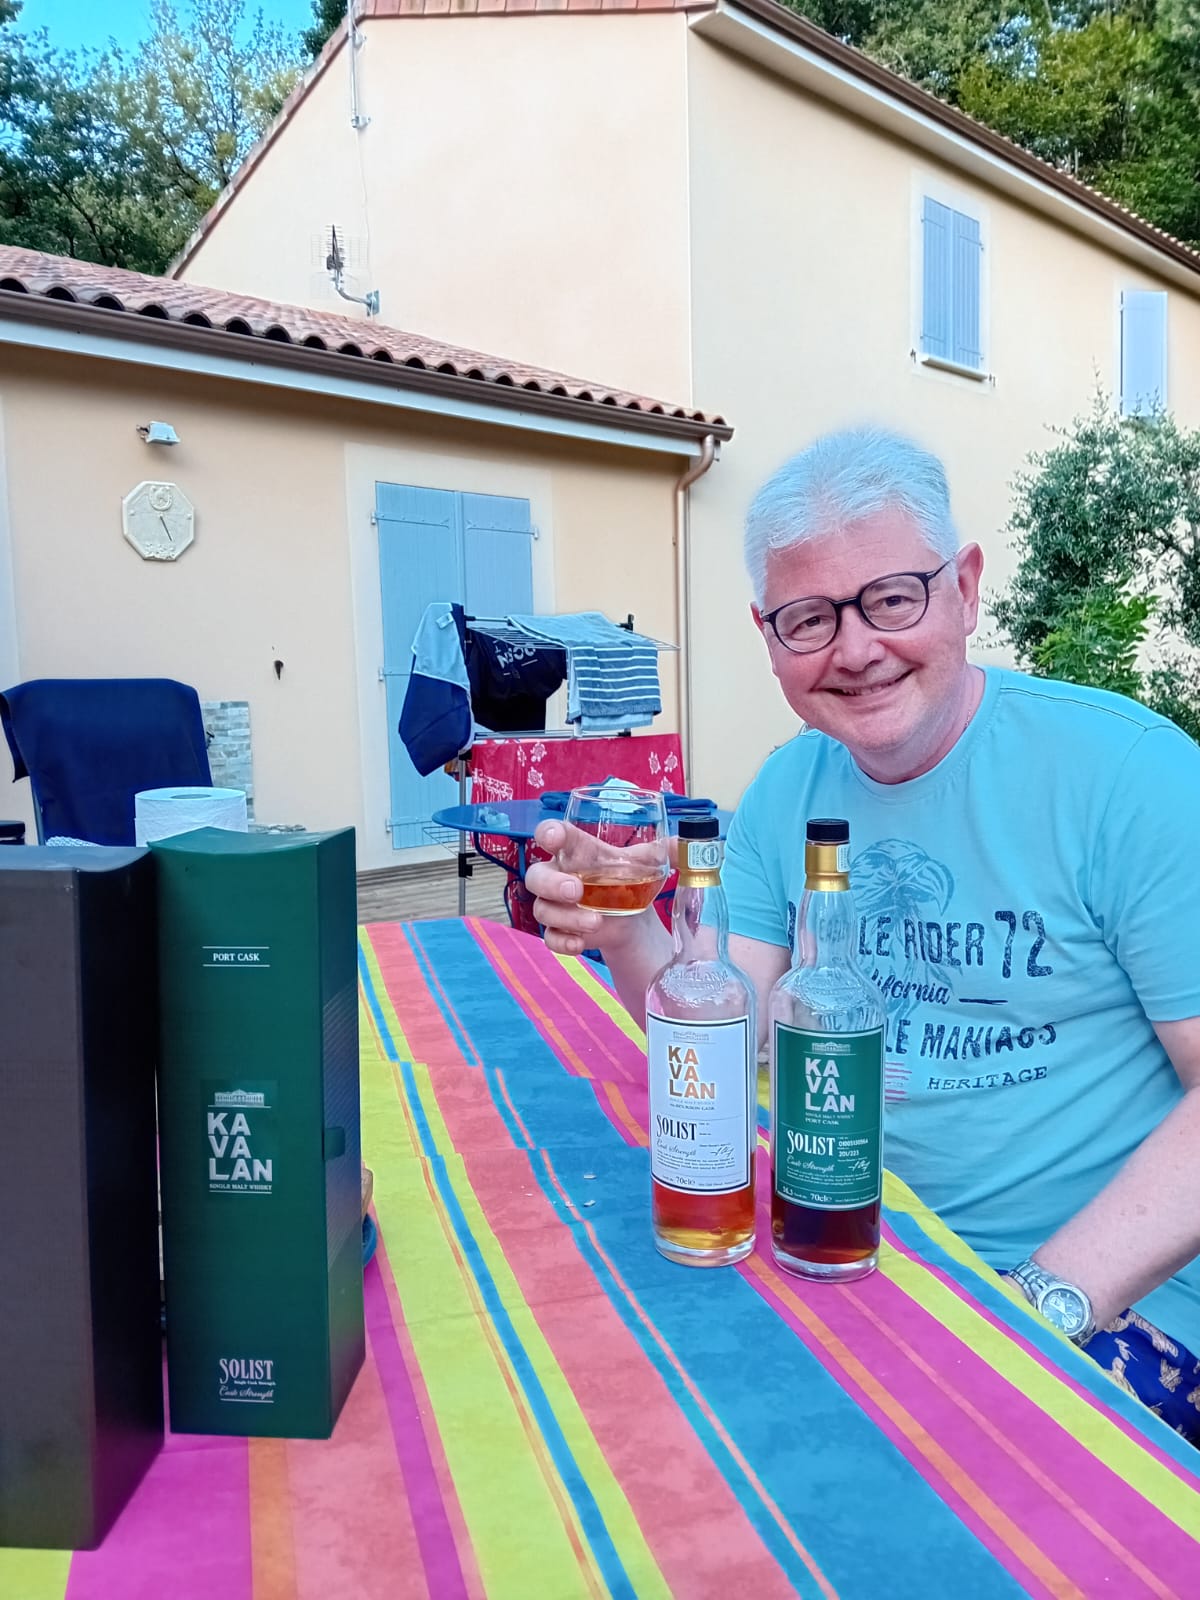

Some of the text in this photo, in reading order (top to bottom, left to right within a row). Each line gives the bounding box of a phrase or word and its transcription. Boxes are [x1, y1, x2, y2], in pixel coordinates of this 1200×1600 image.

[859, 910, 1053, 978] LE RIDER 72
[213, 952, 260, 961] PORT CASK
[886, 1018, 911, 1055] LE
[668, 1045, 699, 1065] KA
[805, 1057, 840, 1077] KA
[669, 1062, 699, 1082] VA
[927, 1066, 1048, 1090] HERITAGE
[669, 1079, 715, 1099] LAN
[805, 1075, 840, 1095] VA
[805, 1092, 855, 1112] LAN
[207, 1112, 251, 1136] KA
[656, 1114, 697, 1141] SOLIST
[208, 1135, 252, 1159] VA
[787, 1130, 835, 1156] SOLIST
[209, 1158, 273, 1182] LAN
[219, 1358, 274, 1385] SOLIST
